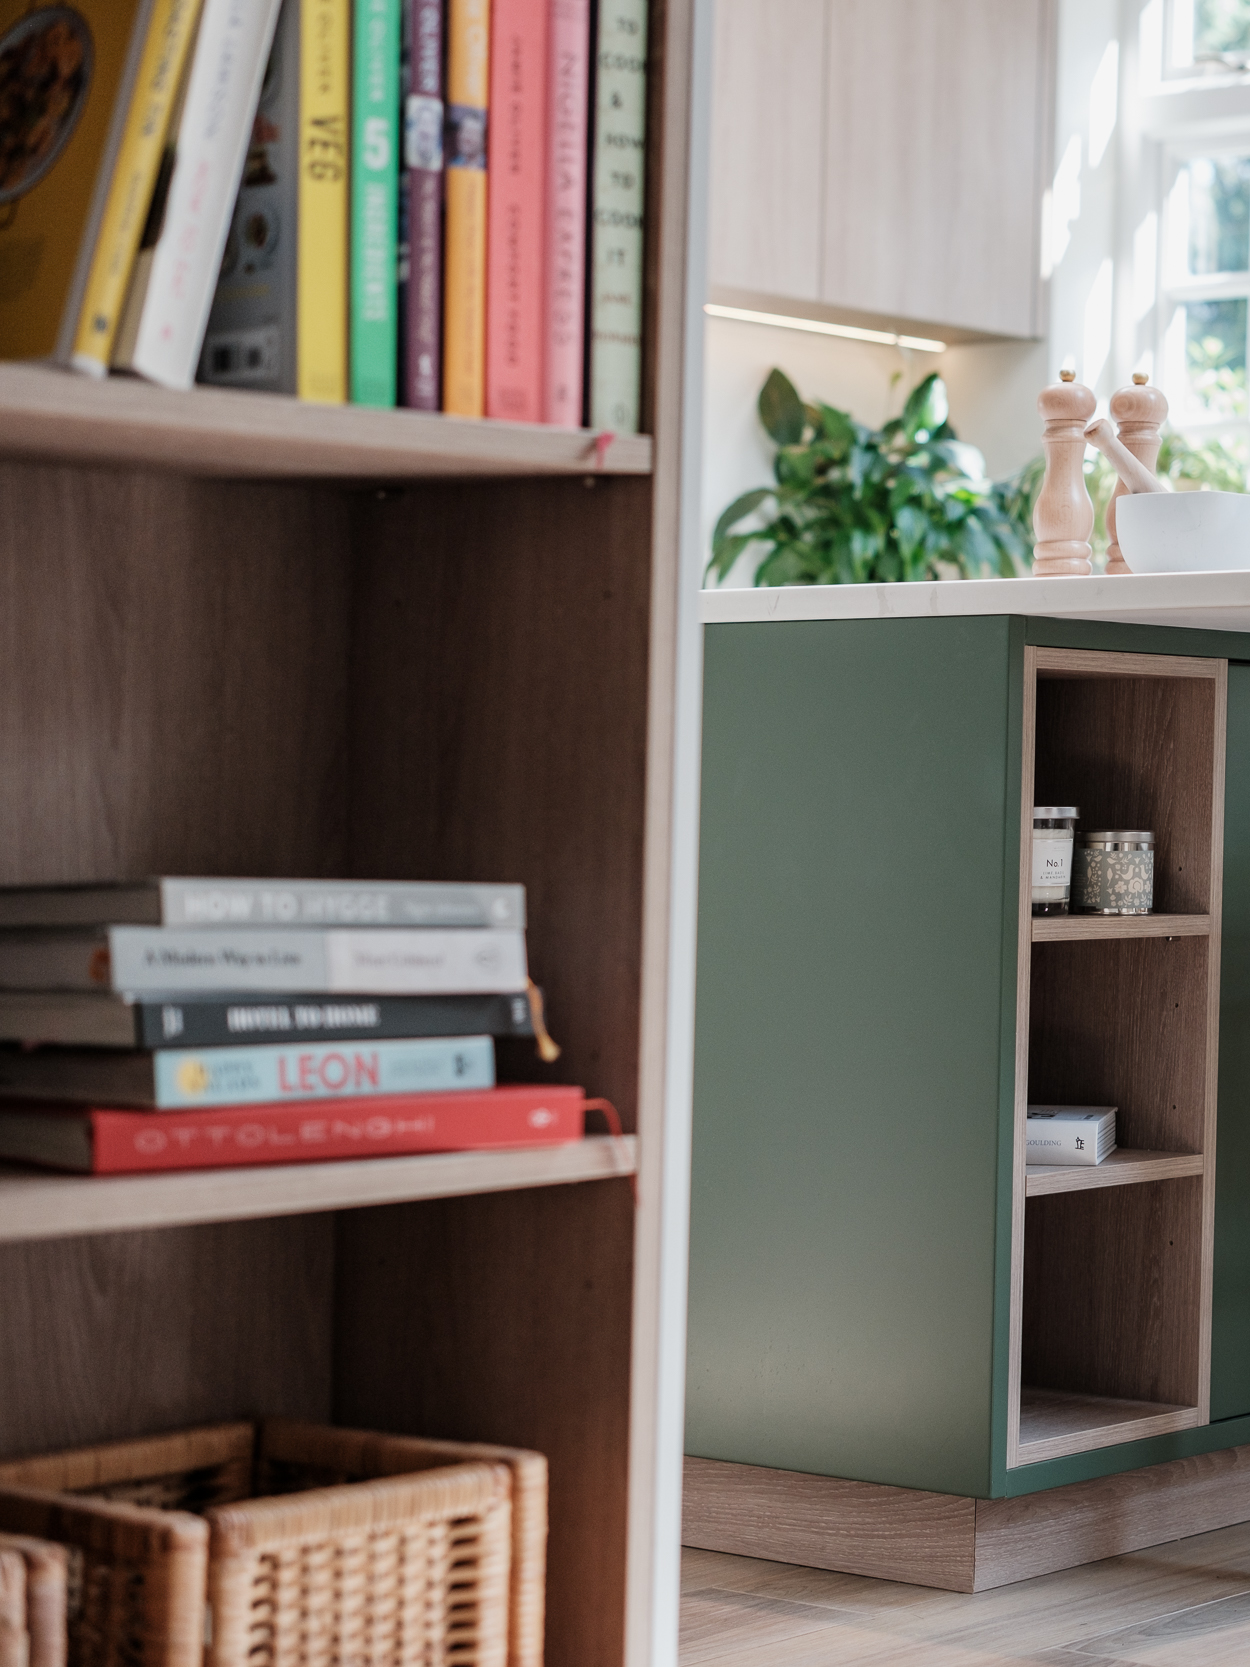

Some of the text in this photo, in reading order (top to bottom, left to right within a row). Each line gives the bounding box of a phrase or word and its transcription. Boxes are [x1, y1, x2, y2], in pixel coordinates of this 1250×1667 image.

[309, 115, 344, 182] VEG
[362, 116, 391, 322] 5 INGREDIENTS
[184, 892, 250, 922] HOW
[261, 892, 299, 923] TO
[306, 894, 391, 923] HYGGE
[278, 1052, 380, 1093] LEON
[133, 1114, 435, 1155] OTTOLENGHI
